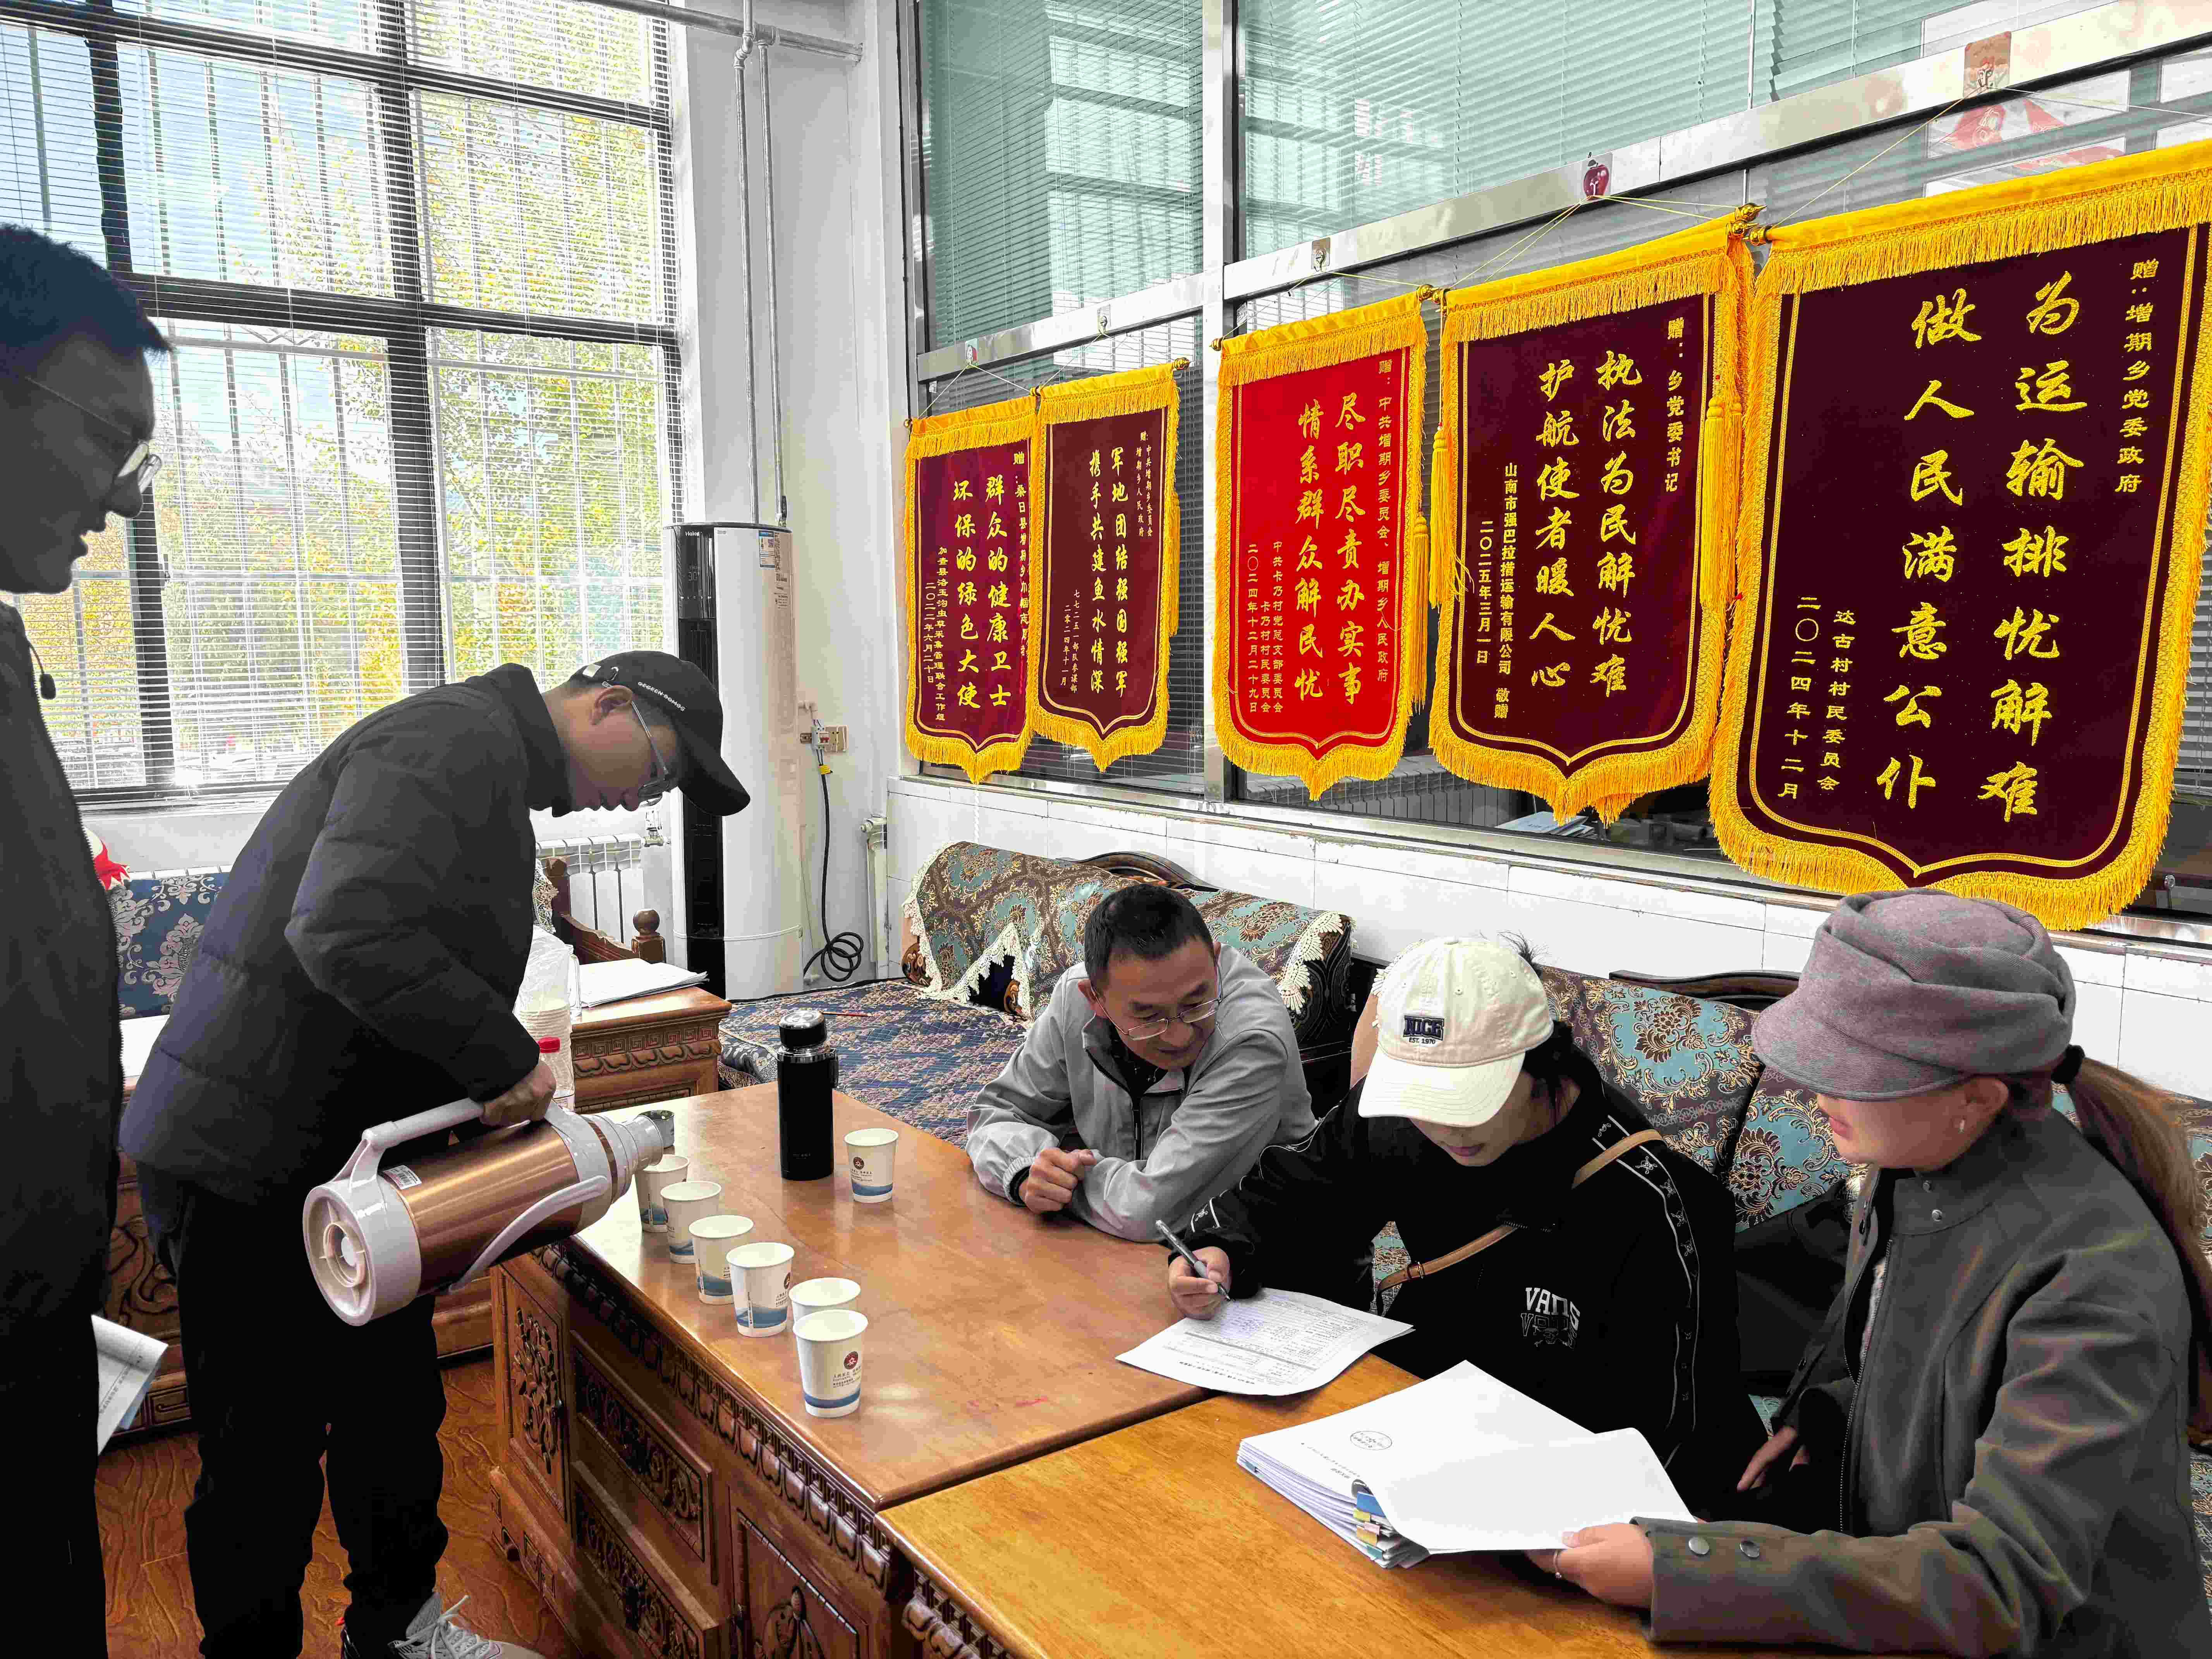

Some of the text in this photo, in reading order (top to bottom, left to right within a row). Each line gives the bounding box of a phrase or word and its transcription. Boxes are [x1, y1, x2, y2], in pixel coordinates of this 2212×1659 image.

[953, 480, 981, 708] 环保的绿色大使
[985, 474, 1012, 706] 群众的健康卫士
[1089, 449, 1106, 694] 携手共建鱼水情深
[1111, 447, 1128, 697] 军地团结强国强军
[1294, 399, 1324, 701] 情系群众解民忧
[1335, 392, 1366, 704] 尽职尽责办实事
[1529, 359, 1580, 687] 护航使者暖人心
[1590, 350, 1642, 697] 执法为民解忧难
[1876, 288, 1982, 809] 做人民满意公仆
[1977, 271, 2087, 823] 为运输排忧解难
[1817, 610, 1856, 790] 达古村村民委员会
[1525, 1287, 1580, 1331] VANS
